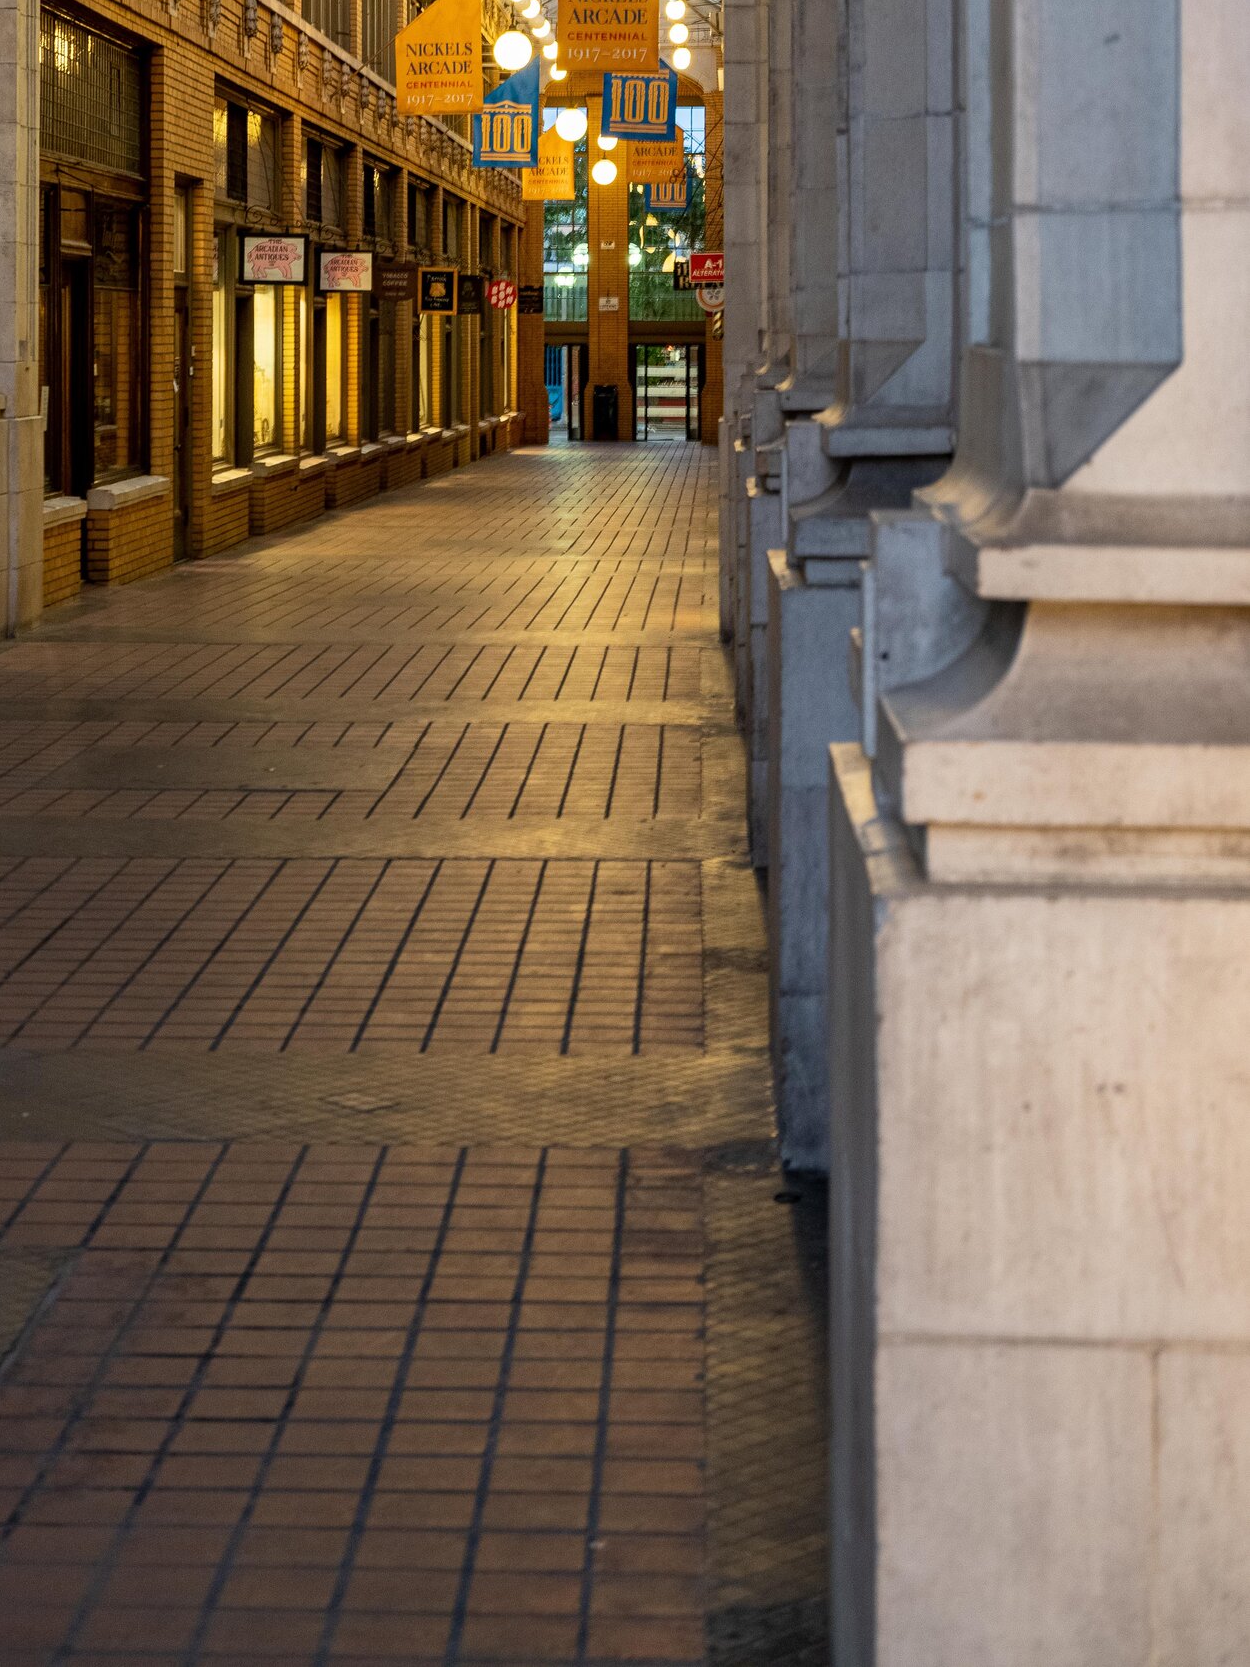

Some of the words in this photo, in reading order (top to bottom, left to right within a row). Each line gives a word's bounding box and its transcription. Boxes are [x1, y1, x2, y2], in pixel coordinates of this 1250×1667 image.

[568, 8, 648, 25] ARCADE
[567, 32, 648, 41] CENTENNIAL
[406, 42, 473, 57] NICKELS
[406, 60, 473, 75] ARCADE
[406, 80, 473, 89] CENTENNIAL
[610, 78, 669, 124] 100
[481, 114, 532, 153] 100
[633, 147, 677, 157] ARCADE
[538, 156, 569, 165] CKELS
[528, 167, 566, 176] ARCADE
[255, 245, 289, 253] ARCADIAN
[255, 253, 289, 261] ANTIQUES
[704, 258, 723, 269] A-1
